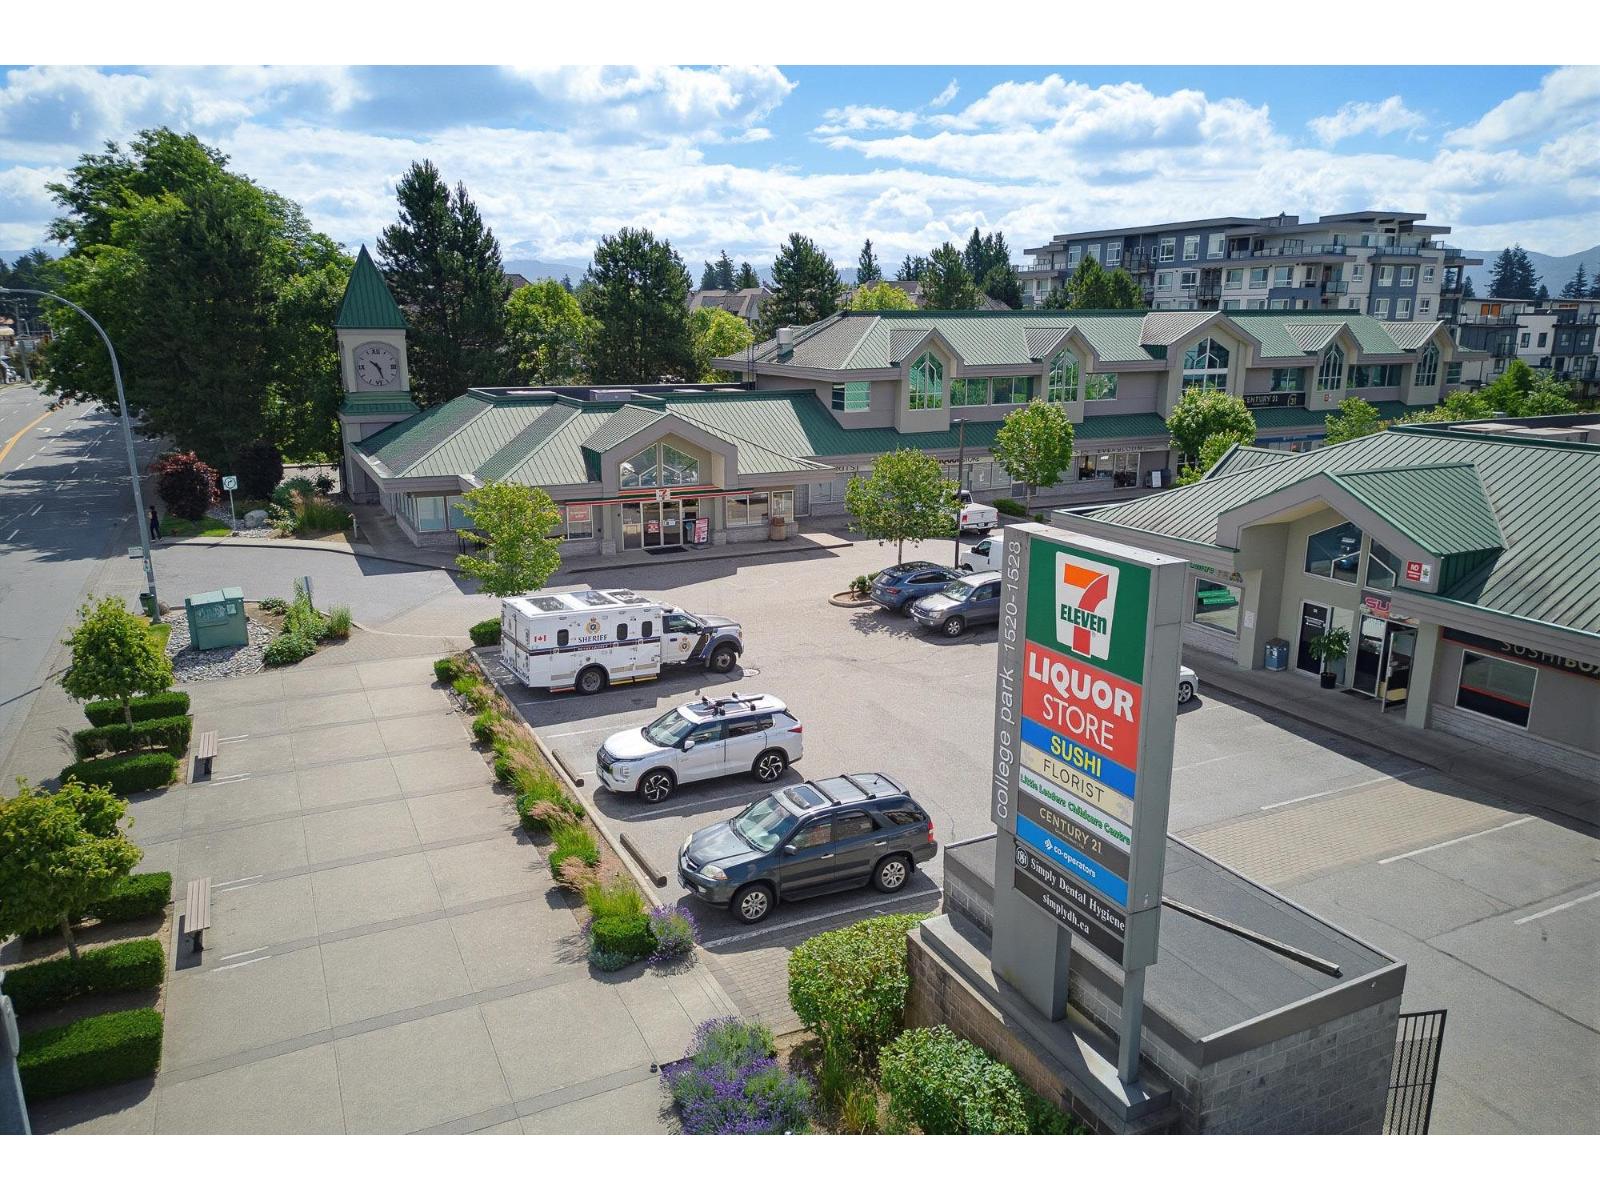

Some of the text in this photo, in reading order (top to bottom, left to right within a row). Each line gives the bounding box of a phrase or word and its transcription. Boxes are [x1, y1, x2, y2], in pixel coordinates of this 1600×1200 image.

[1063, 563, 1110, 657] 7
[578, 634, 608, 643] SHERIFF
[994, 541, 1021, 819] college park 1520-1528
[1028, 651, 1134, 723] LIQUOR
[1042, 694, 1114, 752] STORE
[1050, 735, 1101, 778] SUSHI
[1043, 758, 1104, 803] FLORIST
[1039, 807, 1090, 846] CENTURY
[1091, 839, 1102, 854] 21
[1103, 822, 1131, 846] Centre
[1053, 845, 1096, 878] co-operators
[1030, 858, 1125, 932] Simply Dental Hygiene
[1042, 893, 1090, 934] simplydh.ca
